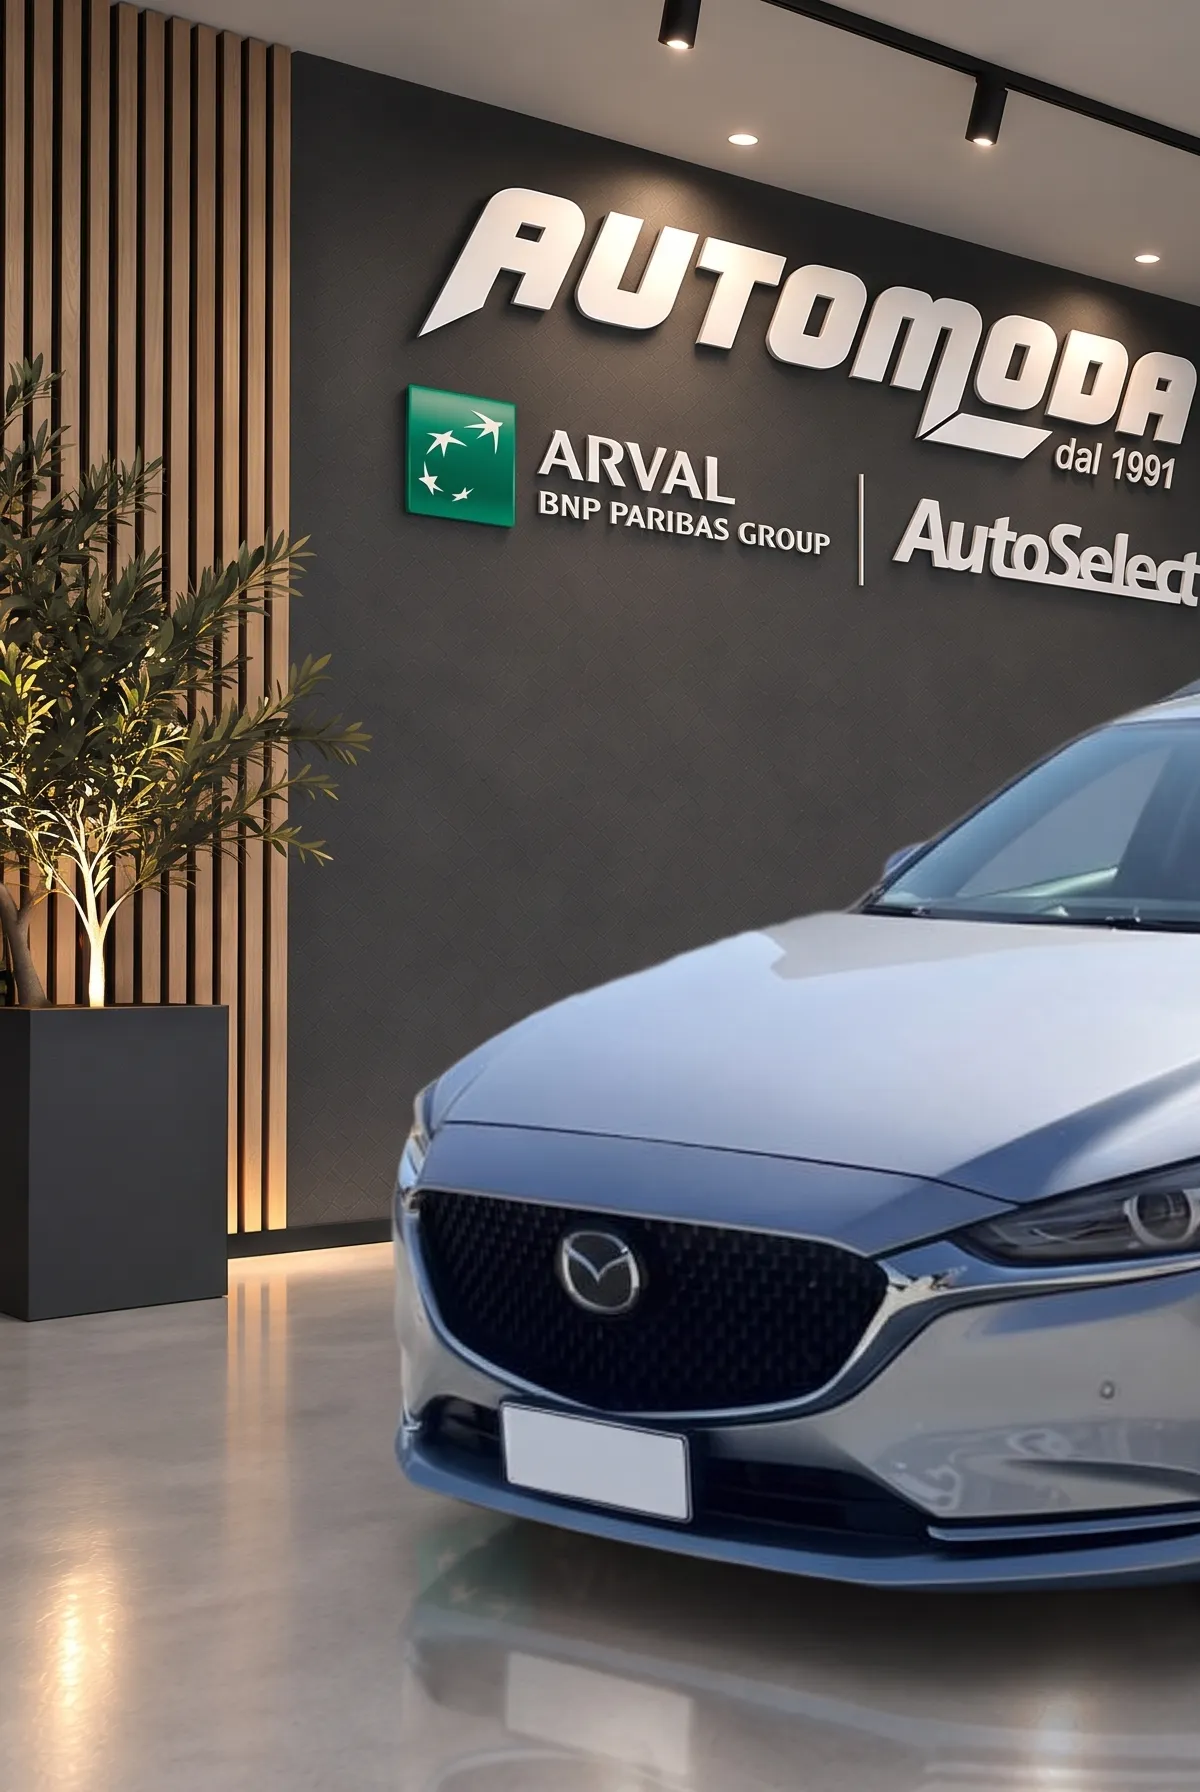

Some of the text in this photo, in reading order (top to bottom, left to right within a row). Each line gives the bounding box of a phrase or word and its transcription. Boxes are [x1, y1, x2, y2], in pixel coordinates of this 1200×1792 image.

[417, 187, 1198, 460] AUTOMODA
[537, 430, 736, 505] ARVAL
[1054, 437, 1176, 489] dal 1991
[538, 490, 831, 555] BNP PARIBAS GROUP
